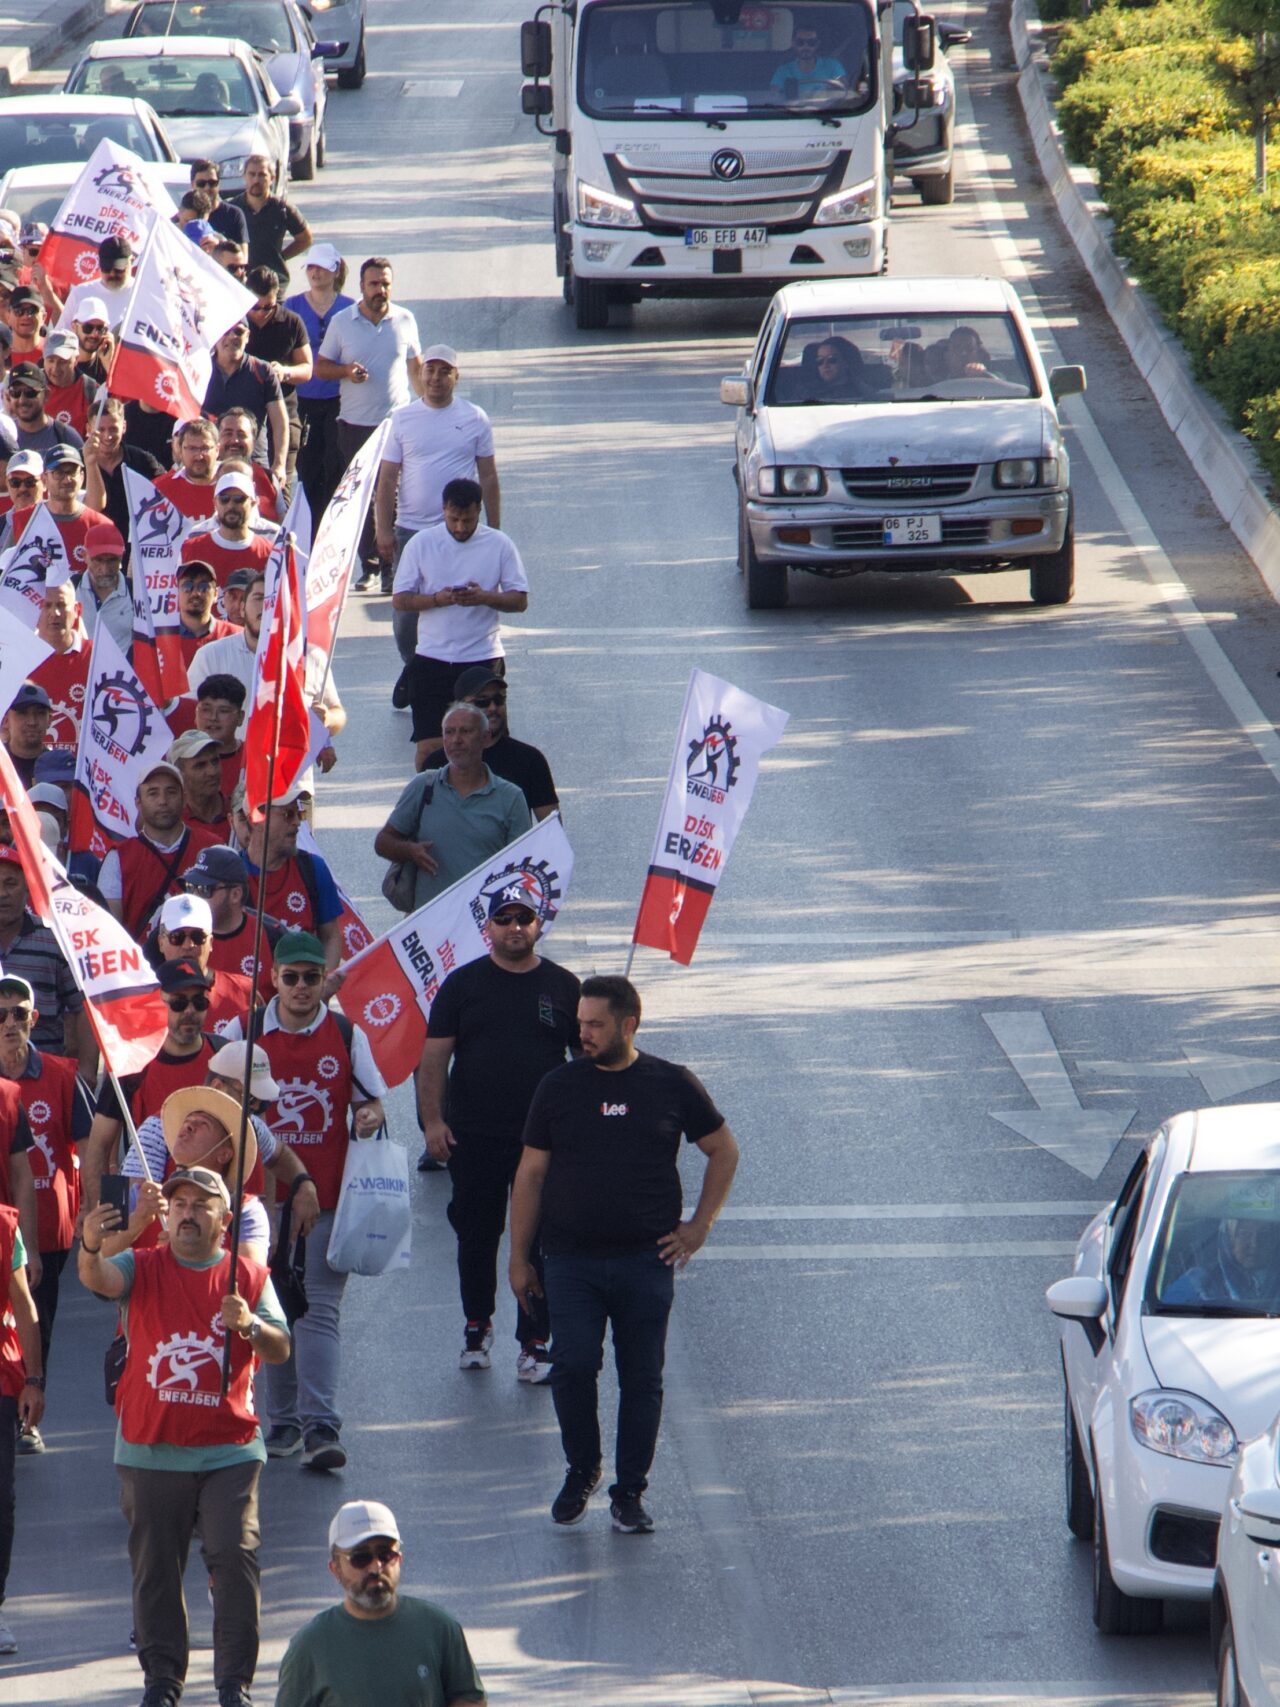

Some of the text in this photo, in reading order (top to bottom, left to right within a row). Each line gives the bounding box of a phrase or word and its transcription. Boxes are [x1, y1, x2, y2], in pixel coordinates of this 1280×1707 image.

[98, 203, 128, 222] DİSK
[693, 229, 765, 244] 06 EFB 447
[887, 477, 932, 488] ISUZU
[885, 518, 924, 530] 06 PJ
[908, 530, 929, 541] 325
[684, 815, 717, 840] DİSK
[436, 939, 456, 975] DİSK
[603, 1102, 626, 1116] Lee
